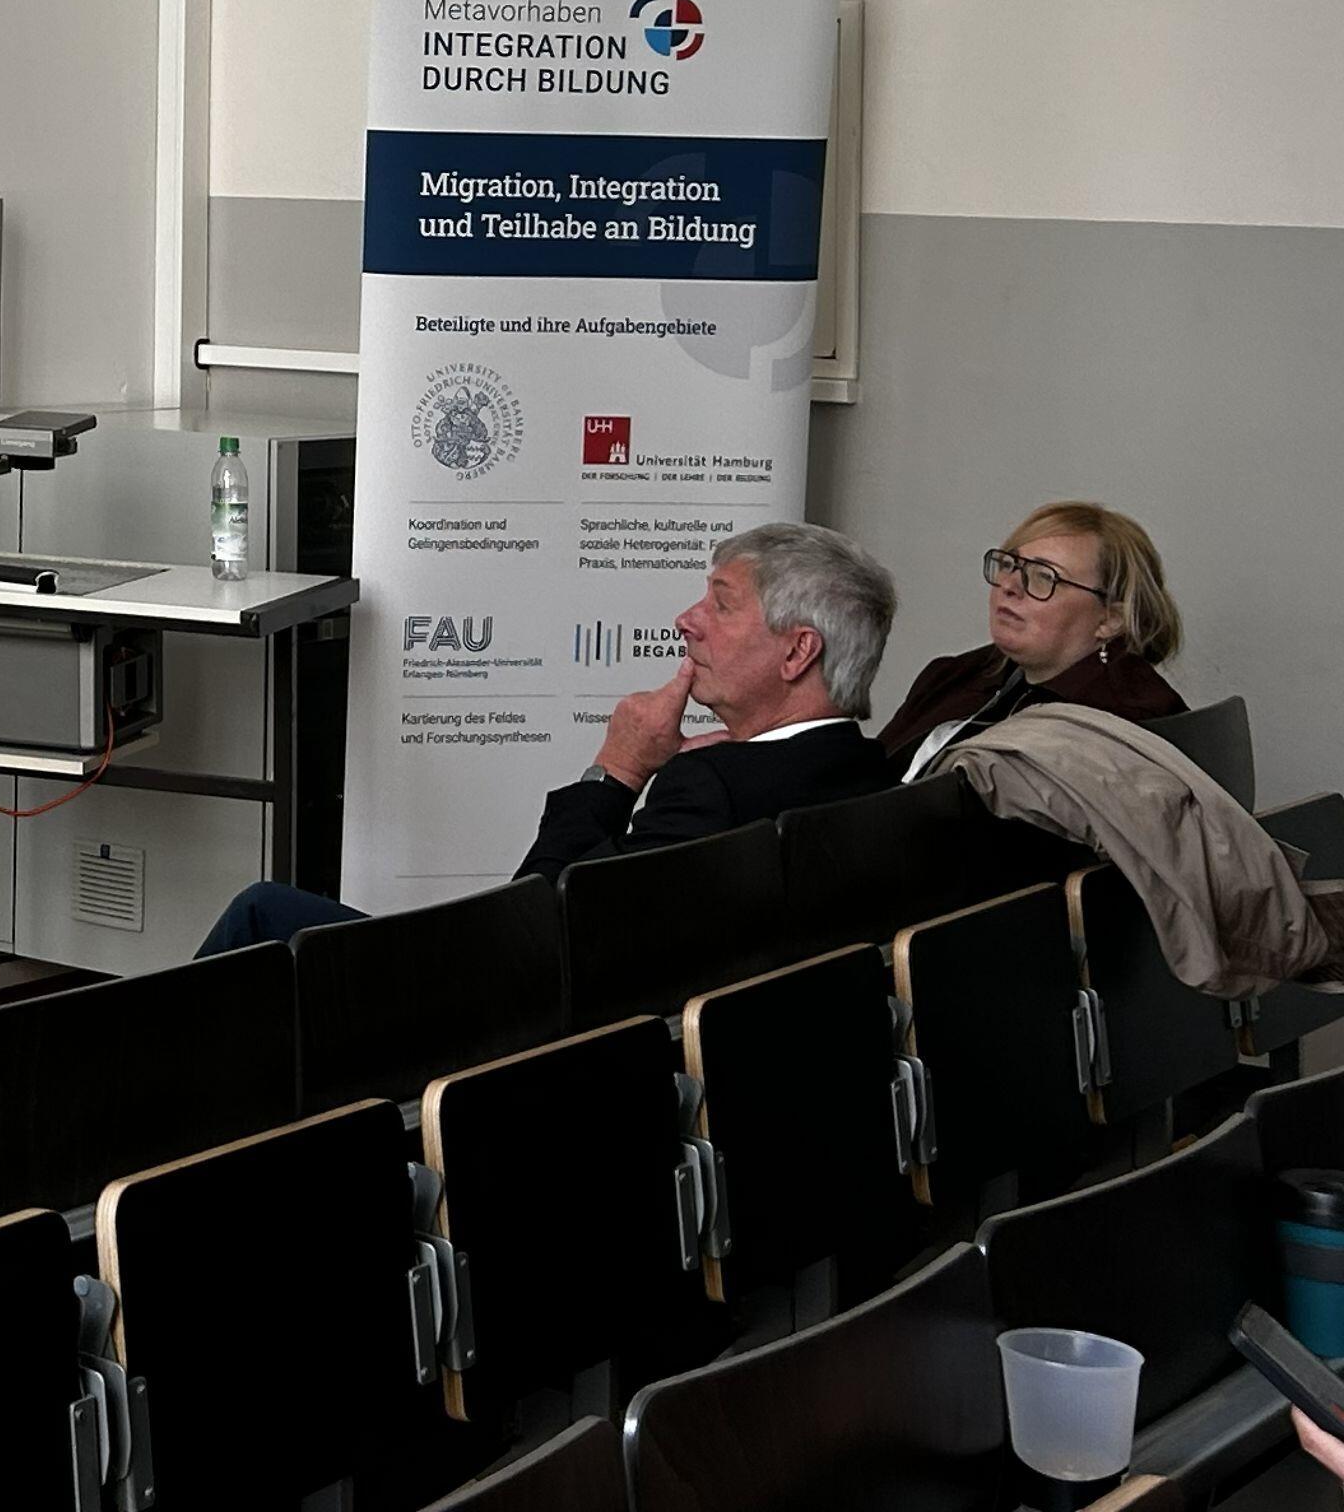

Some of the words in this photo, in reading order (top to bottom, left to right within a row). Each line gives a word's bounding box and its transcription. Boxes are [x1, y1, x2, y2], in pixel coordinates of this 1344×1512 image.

[423, 31, 628, 60] INTEGRATION
[422, 66, 527, 93] DURCH
[538, 69, 670, 95] BILDUNG
[420, 171, 562, 203] Migration,
[569, 174, 721, 204] Integration
[418, 212, 473, 239] und
[481, 213, 597, 240] Teilhabe
[605, 221, 639, 240] an
[647, 216, 757, 248] Bildung
[415, 315, 495, 335] Beteiligte
[500, 317, 532, 334] und
[537, 317, 571, 334] ihre
[576, 318, 717, 337] Aufgabengebiete
[636, 455, 707, 468] Universität
[713, 455, 773, 471] Hamburg
[408, 517, 481, 532] Koordination
[654, 519, 708, 532] kulturelle
[407, 537, 540, 552] Gelingensbedingungen
[403, 615, 494, 653] FAU
[401, 712, 462, 727] Kartierung
[464, 712, 486, 725] des
[488, 712, 527, 725] Feldes
[401, 731, 424, 745] und
[427, 730, 552, 746] Forschungssynthesen
